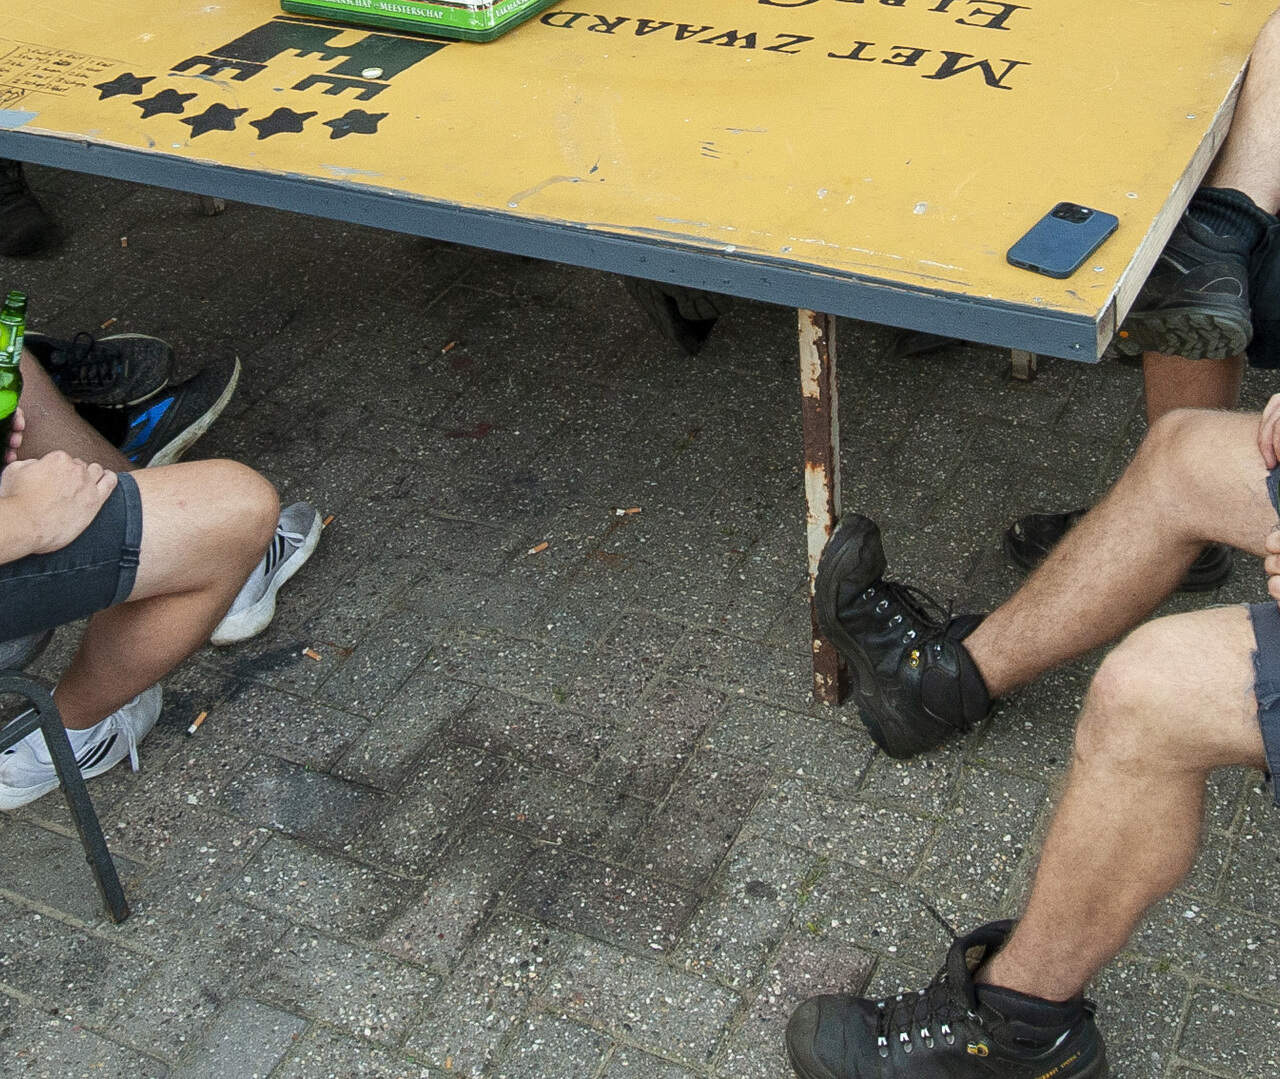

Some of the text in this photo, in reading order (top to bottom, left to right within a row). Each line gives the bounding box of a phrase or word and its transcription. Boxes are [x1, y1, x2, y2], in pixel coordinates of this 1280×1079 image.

[379, 2, 443, 19] MEESTERSCHAP
[540, 10, 814, 54] ZWAARD
[828, 40, 1032, 90] MET
